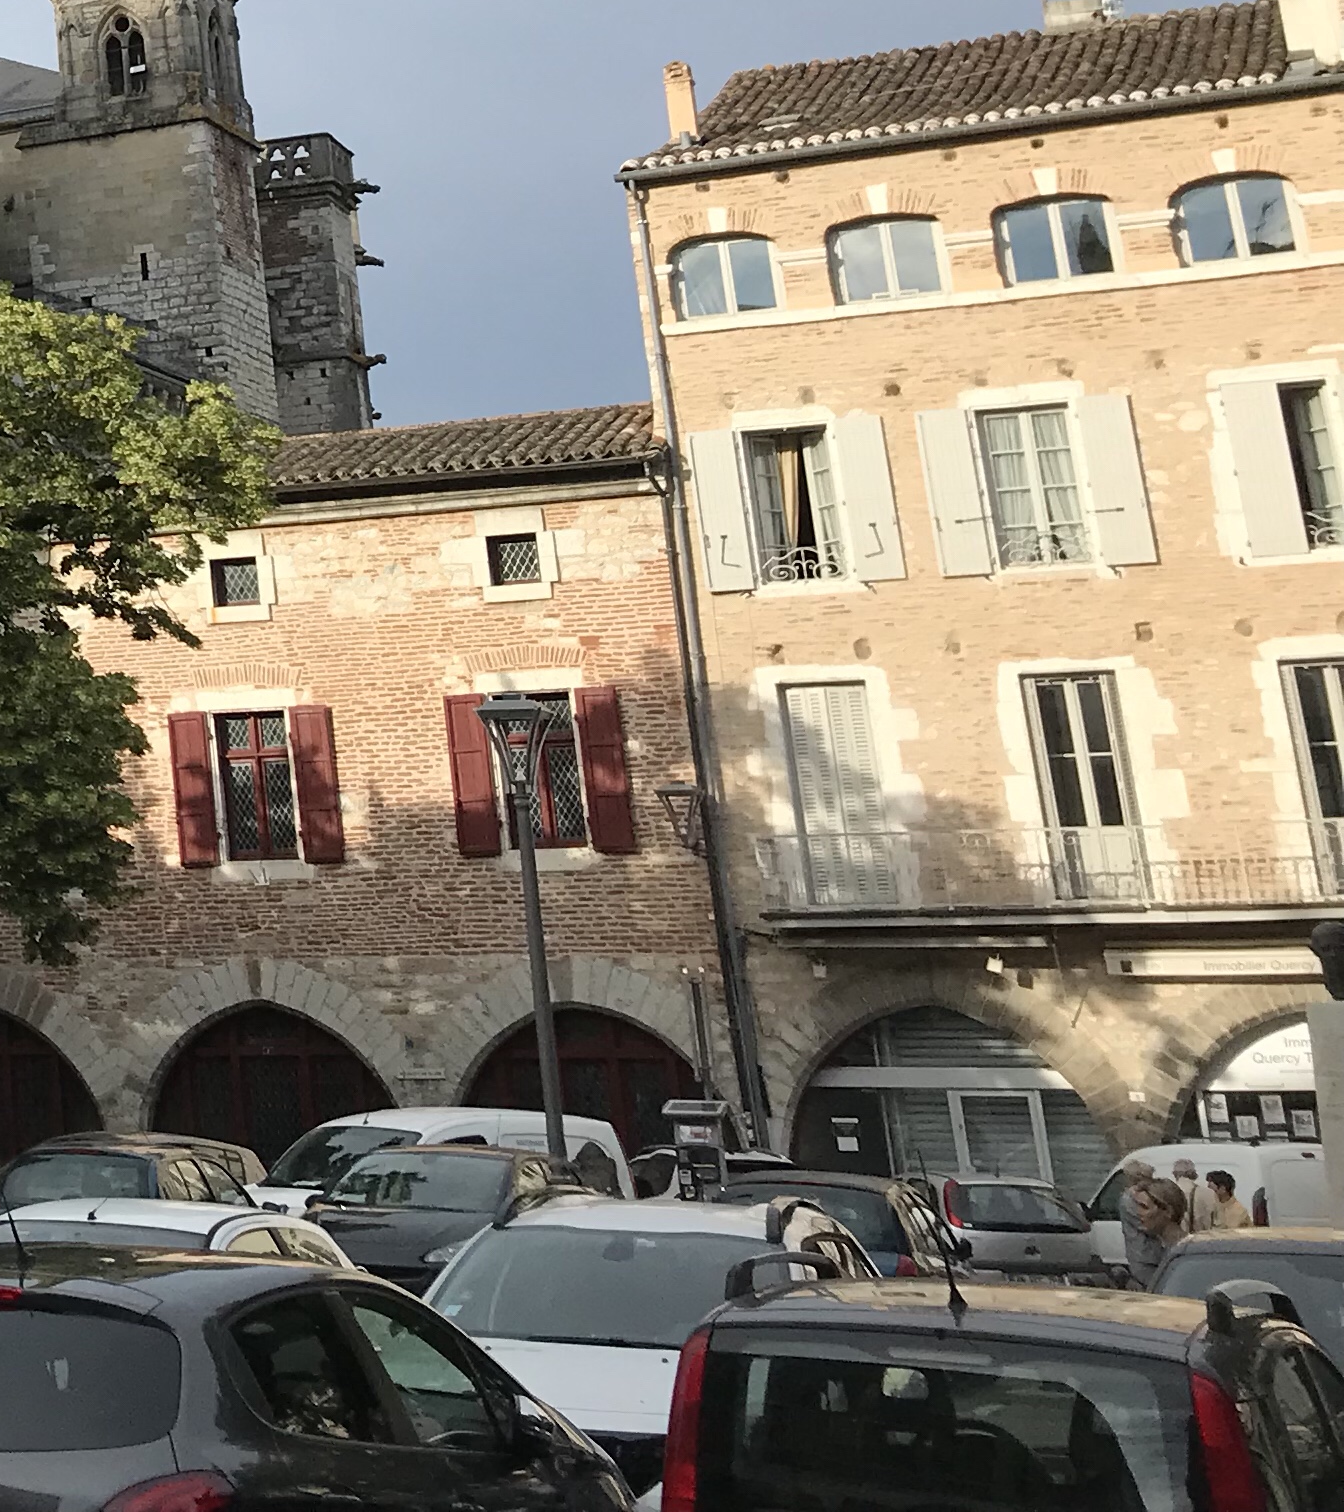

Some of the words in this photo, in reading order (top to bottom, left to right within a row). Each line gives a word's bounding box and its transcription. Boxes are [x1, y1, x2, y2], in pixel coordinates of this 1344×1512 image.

[1203, 960, 1266, 972] Immobilier
[1270, 959, 1316, 973] Quercy
[1252, 1051, 1300, 1066] Quercy
